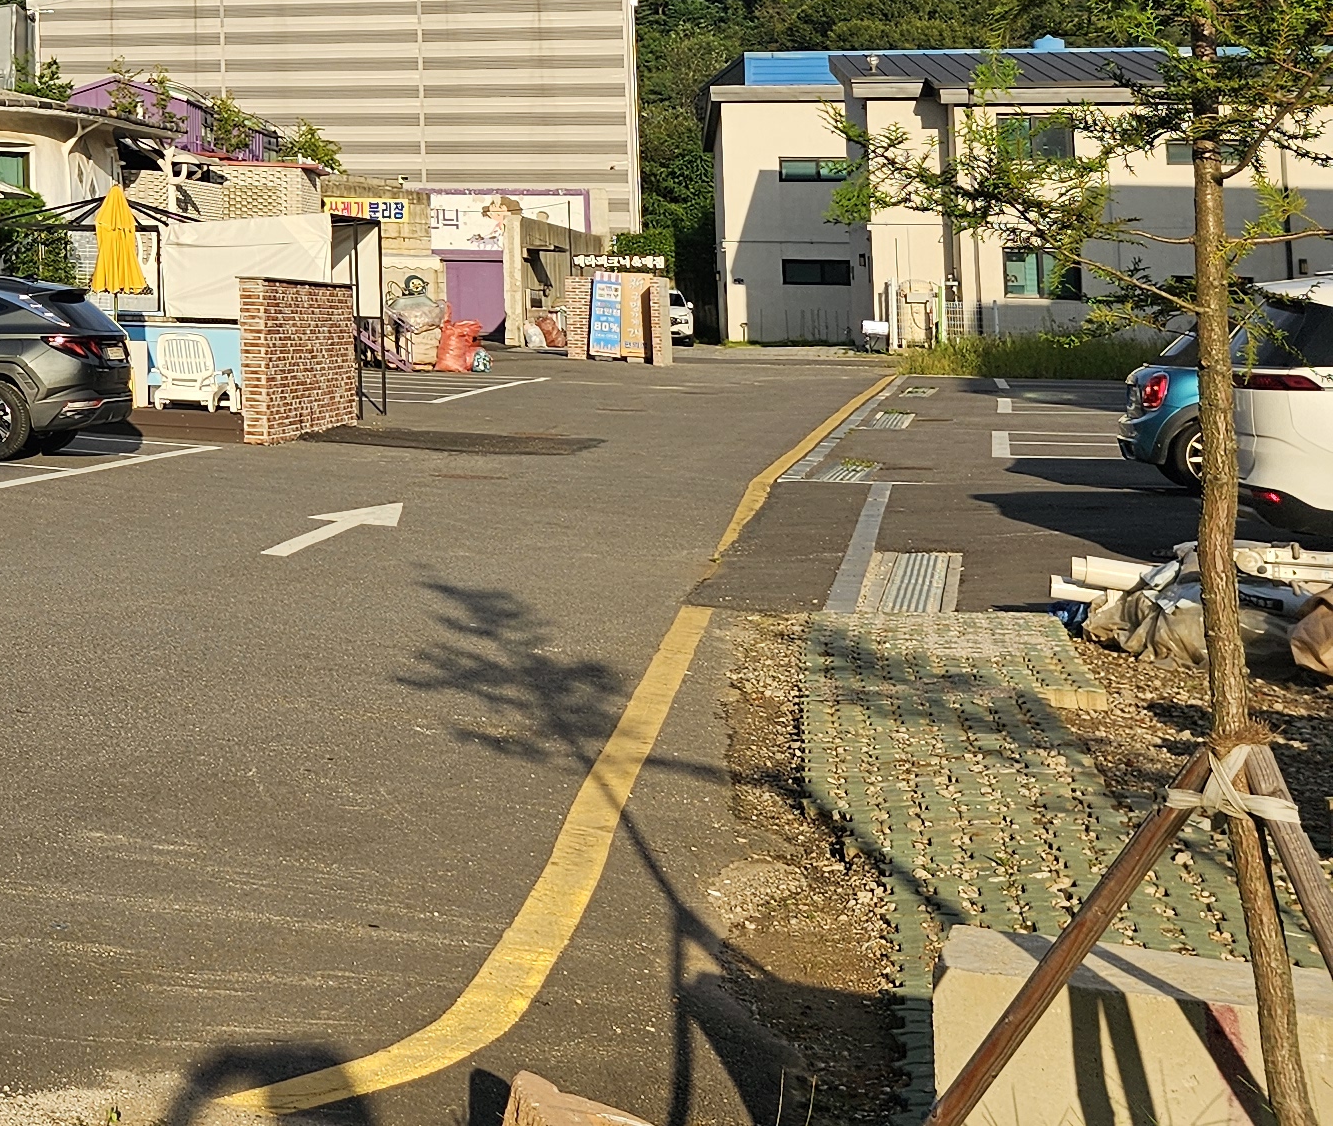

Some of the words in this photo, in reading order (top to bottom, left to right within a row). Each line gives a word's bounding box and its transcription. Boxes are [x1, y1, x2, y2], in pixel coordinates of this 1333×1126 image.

[329, 201, 364, 218] 쓰레기
[368, 201, 405, 220] 분리장
[594, 322, 620, 333] 80%
